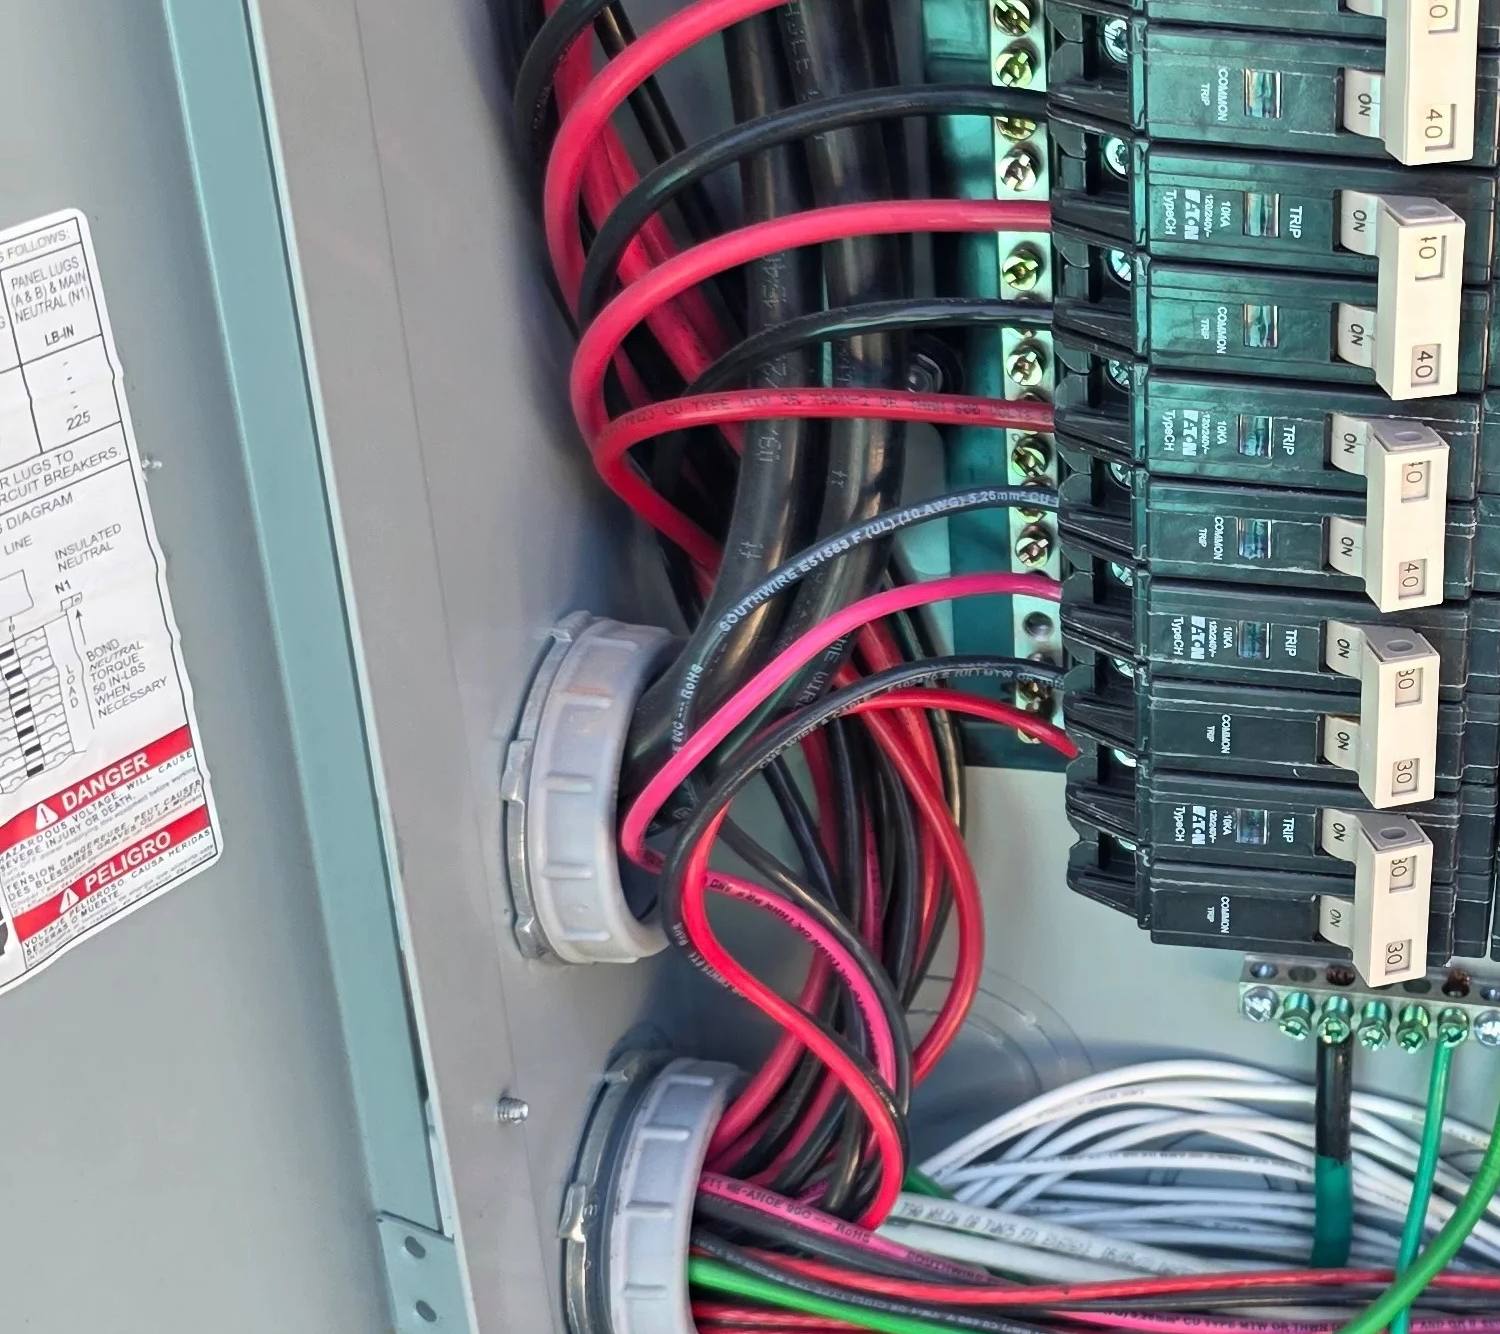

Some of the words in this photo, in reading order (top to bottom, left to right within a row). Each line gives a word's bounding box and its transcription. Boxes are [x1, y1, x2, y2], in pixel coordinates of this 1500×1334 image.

[1358, 92, 1371, 117] ON
[1425, 108, 1443, 140] 40
[1353, 209, 1366, 233] ON
[7, 229, 70, 259] FOLLOWS:
[11, 269, 48, 291] PANEL
[48, 256, 80, 277] LUGS
[58, 270, 87, 290] MAIN
[14, 296, 67, 324] NEUTRAL
[68, 286, 90, 306] (N1)
[44, 324, 75, 346] LB-IN
[1415, 350, 1433, 378] 40
[66, 410, 91, 431] 225
[1343, 432, 1356, 454] ON
[13, 458, 52, 485] LUGS
[54, 450, 74, 465] TO
[43, 446, 122, 487] BREAKERS.
[5, 491, 74, 531] DIAGRAM
[4, 534, 34, 556] LINE
[54, 523, 122, 560] INSULATED
[57, 541, 115, 573] NEUTRAL
[54, 579, 72, 594] N1
[1402, 562, 1419, 588] 40
[719, 569, 799, 632] SOUTHWIRE
[86, 638, 120, 662] BOND
[89, 640, 144, 671] NEUTRAL
[90, 652, 140, 683] TORQUE
[108, 661, 146, 688] IN-LBS
[680, 663, 703, 700] RoHS
[94, 683, 131, 707] WHEN
[98, 675, 167, 719] NECESSARY
[61, 752, 150, 811] DANGER
[126, 774, 153, 791] WILL
[158, 750, 193, 774] CAUSE
[1396, 759, 1414, 785] 30
[45, 824, 82, 849] INJURY
[85, 816, 98, 827] OR
[85, 831, 171, 893] PELIGRO
[131, 856, 165, 879] CAUSA
[168, 829, 211, 858] HERIDAS
[6, 863, 55, 894] TENSION
[1386, 941, 1404, 966] 30
